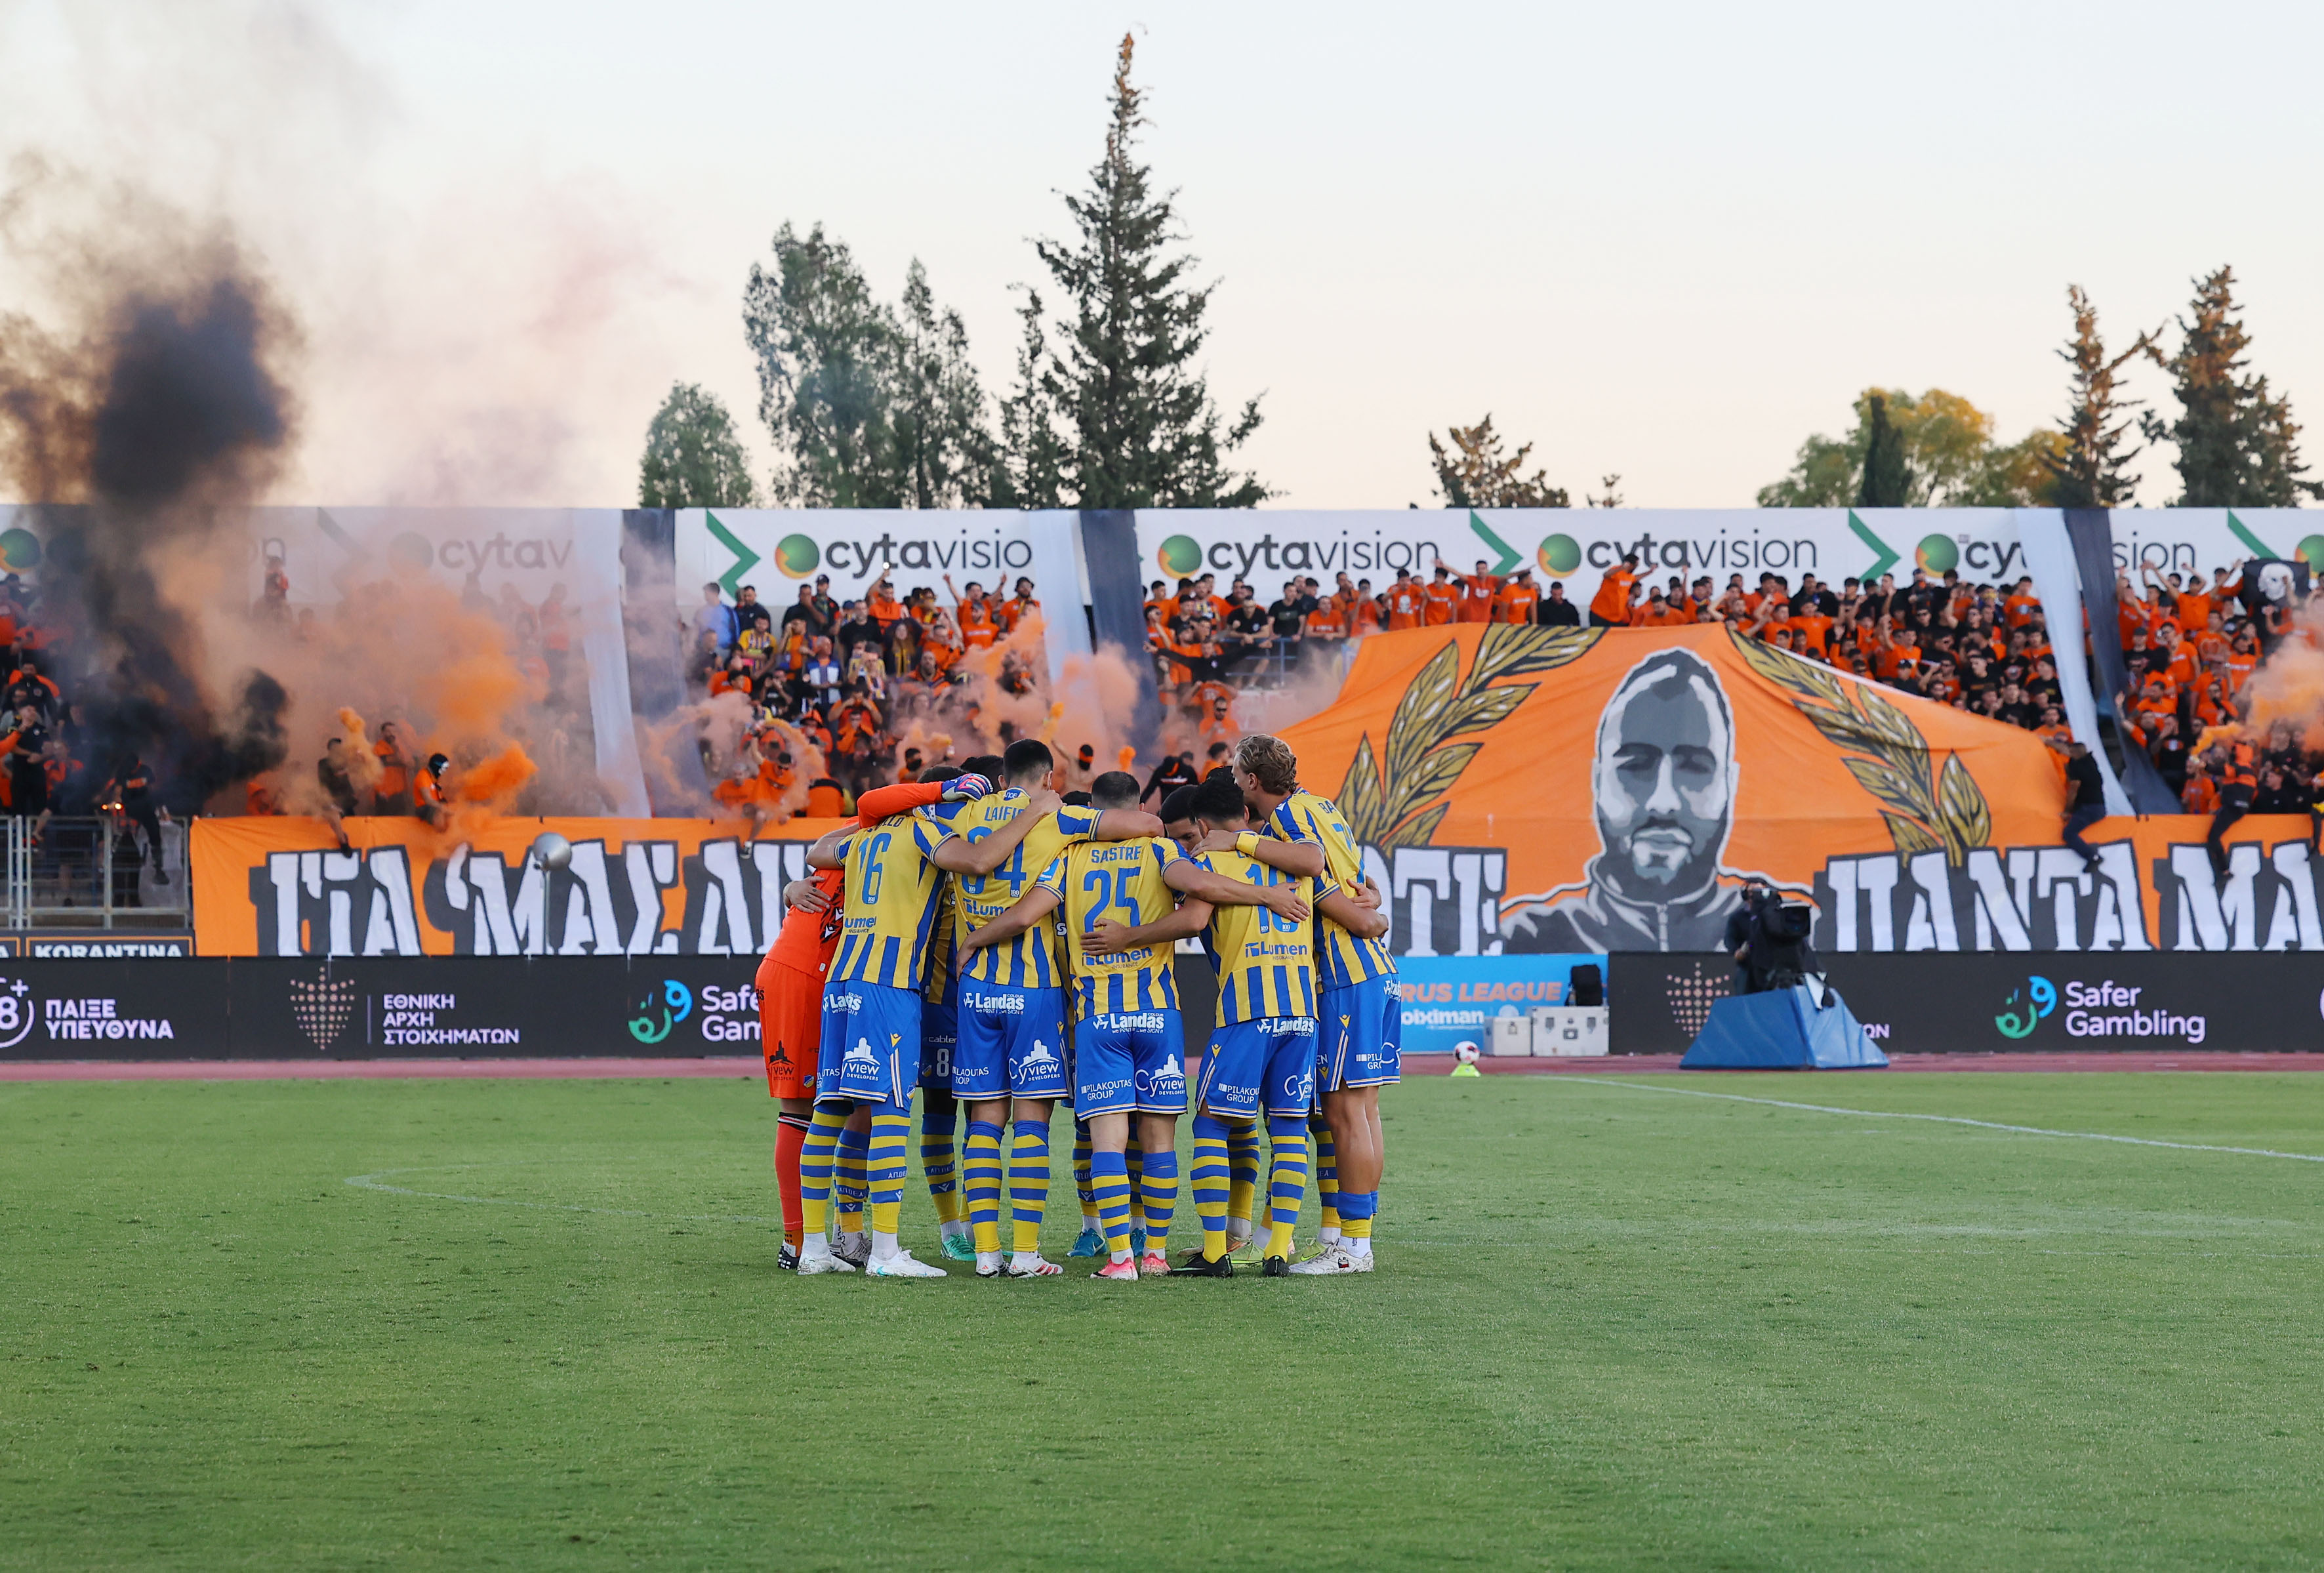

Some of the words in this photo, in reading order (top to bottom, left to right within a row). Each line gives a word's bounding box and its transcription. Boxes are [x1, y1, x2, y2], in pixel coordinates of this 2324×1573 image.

[826, 529, 1032, 579] cytavisio
[1208, 530, 1439, 579] cytavision
[1587, 529, 1818, 569] cytavision
[1965, 541, 2028, 579] cy
[1091, 846, 1142, 863] SASTRE
[859, 833, 892, 905] 16
[1084, 867, 1141, 933] 25
[1095, 947, 1153, 965] Lumen
[1260, 941, 1308, 956] Lumen
[382, 993, 455, 1010] ΕΘΝΙΚΗ
[975, 992, 1025, 1011] Landas
[1458, 981, 1562, 1002] LEAGUE
[2065, 981, 2142, 1009] Safer
[45, 998, 117, 1019] ΠΑΙΞΕ
[44, 1019, 174, 1040] ΥΠΕΥΘΥΝΑ
[382, 1011, 434, 1028] ΑΡΧΗ
[1109, 1012, 1164, 1029] Landas
[1273, 1017, 1315, 1033] Landas
[2065, 1010, 2206, 1044] Gambling
[383, 1028, 520, 1045] ΣΤΟΙΧΗΜΑΤΩΝ
[936, 1048, 949, 1077] 8
[1008, 1057, 1059, 1085] Cyview
[846, 1072, 879, 1081] DEVELOPERS
[1086, 1078, 1132, 1092] PILAKOUTAS
[1087, 1090, 1114, 1101] GROUP
[1226, 1093, 1255, 1104] GROUP
